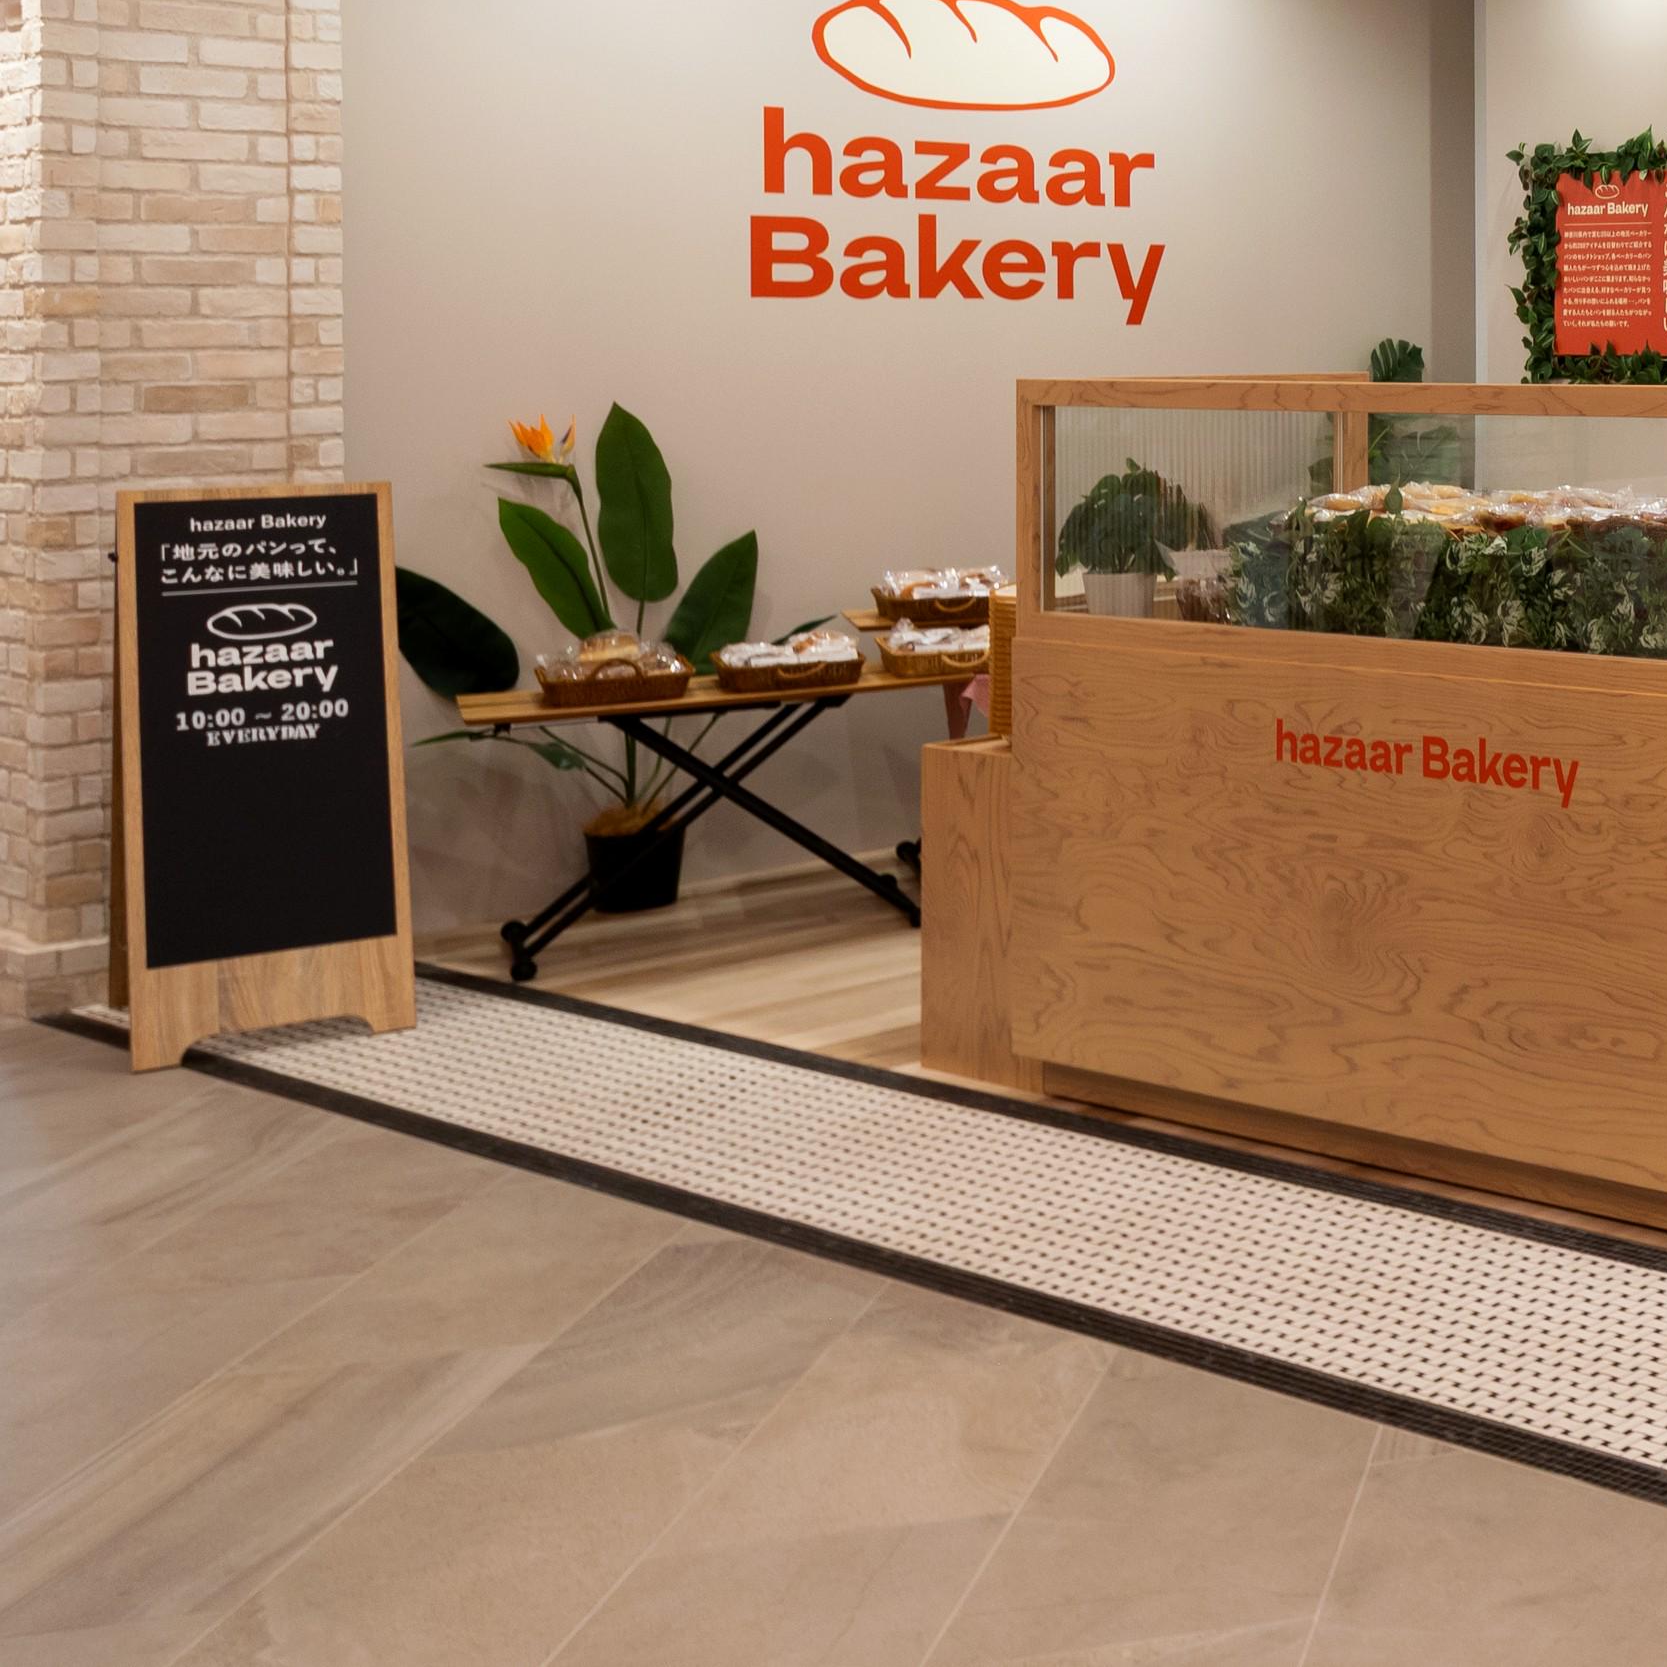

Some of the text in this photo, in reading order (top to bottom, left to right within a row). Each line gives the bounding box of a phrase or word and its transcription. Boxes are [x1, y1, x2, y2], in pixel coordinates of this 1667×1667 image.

[764, 106, 1155, 207] hazaar
[1567, 200, 1649, 218] hazaar Bakery
[750, 214, 1166, 326] Bakery
[190, 513, 327, 532] hazaar Bakery
[161, 537, 337, 562] 「地元のパンって、
[161, 557, 358, 584] こんなに美味しい。」
[191, 639, 334, 668] hazaar
[187, 665, 338, 696] Bakery
[176, 707, 246, 731] 10:00
[281, 698, 349, 722] 20:00
[206, 723, 320, 747] EVERYDAY
[1276, 718, 1579, 809] hazaar Bakery
